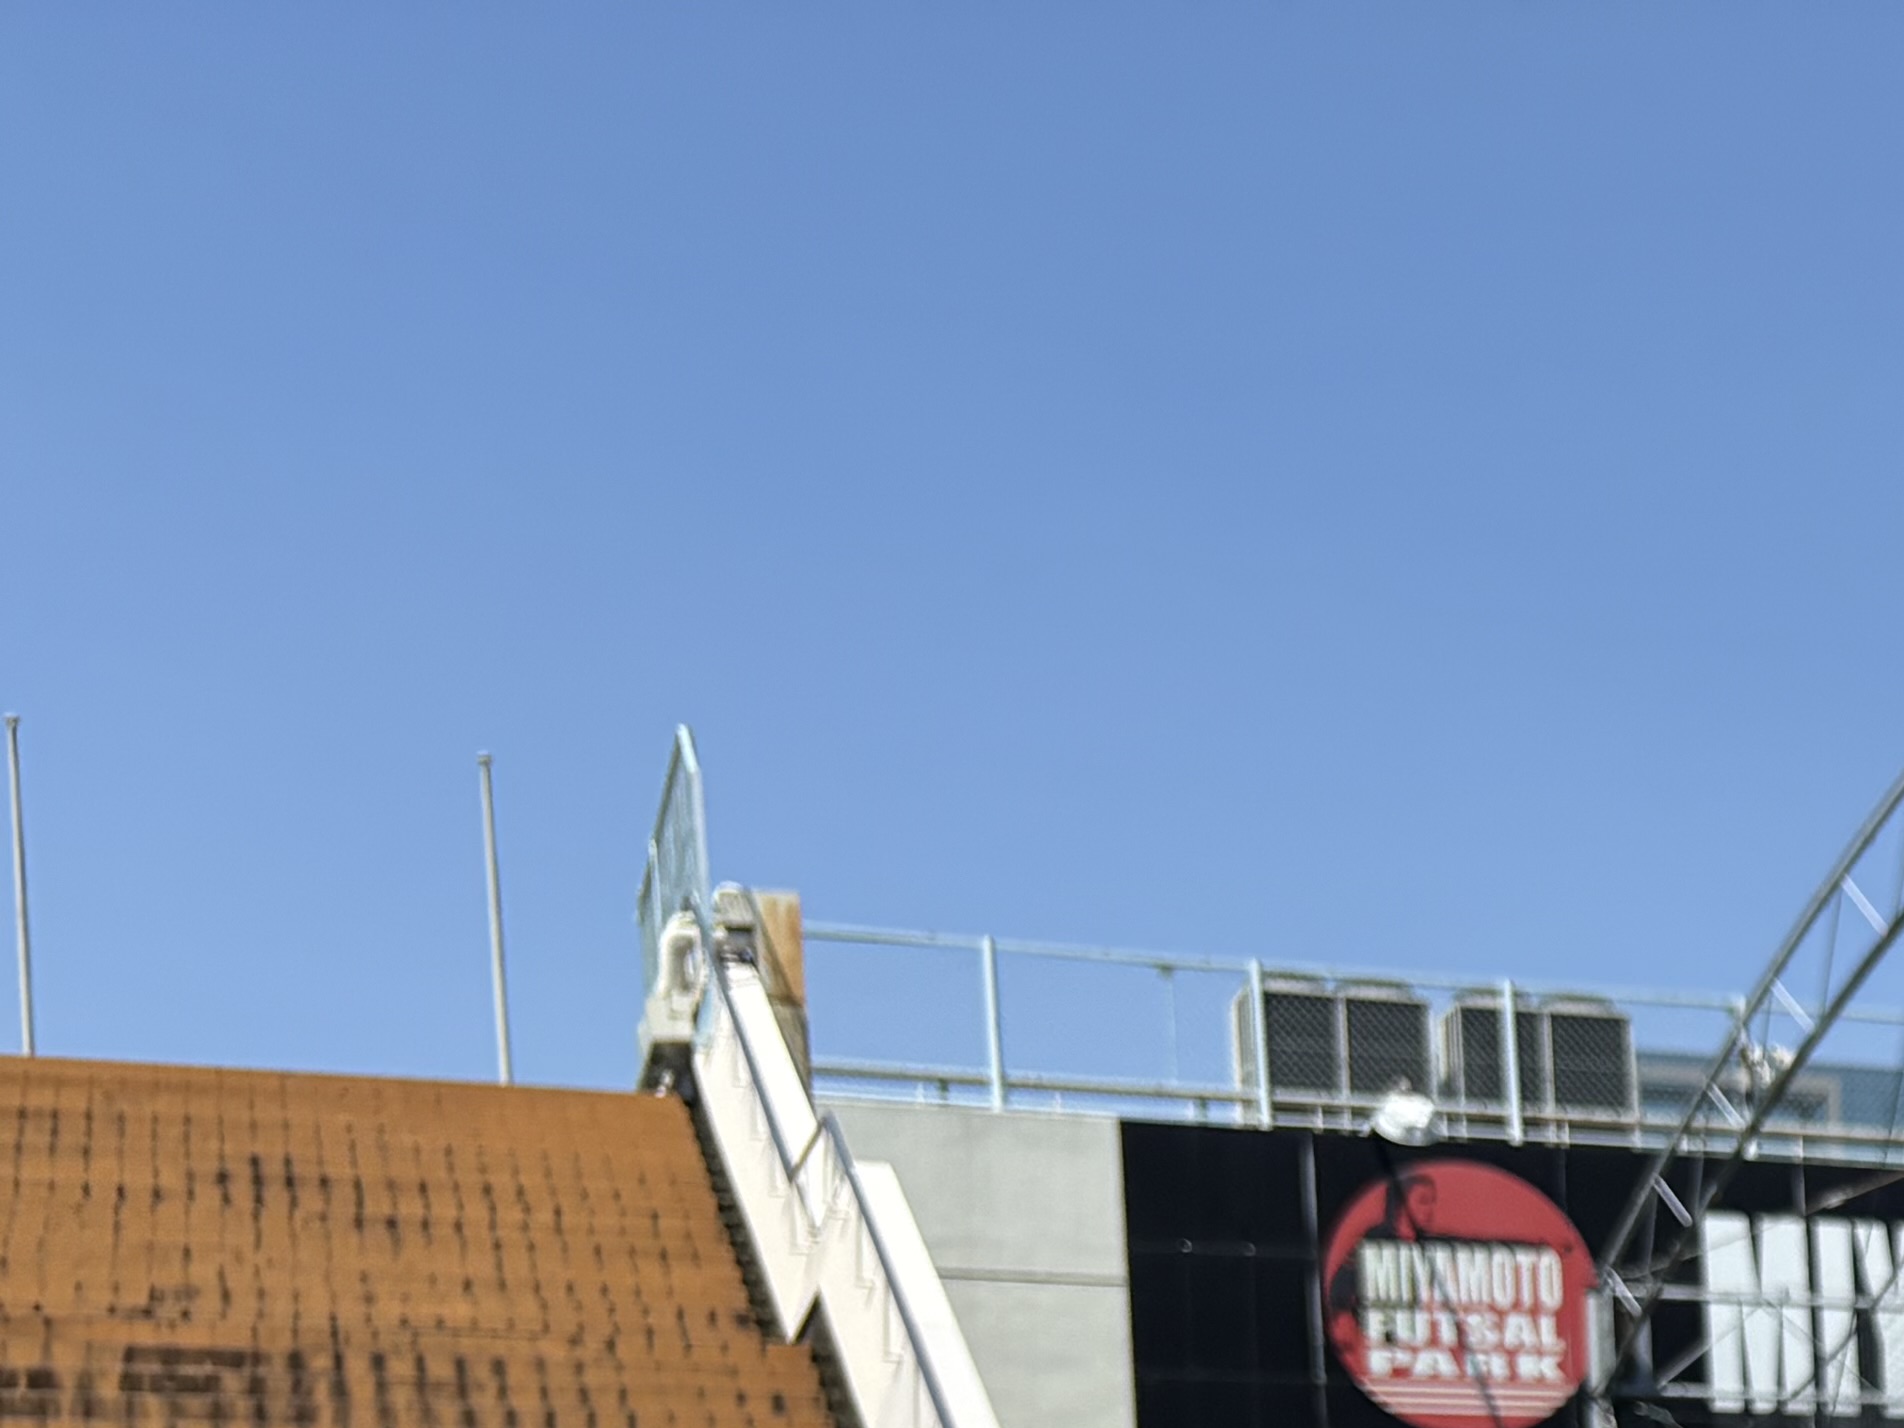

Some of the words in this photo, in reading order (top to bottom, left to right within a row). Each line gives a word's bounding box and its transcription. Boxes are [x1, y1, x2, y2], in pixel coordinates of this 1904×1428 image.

[1361, 1238, 1563, 1311] MIYAMOTO
[1366, 1306, 1567, 1352] FUTSAL
[1367, 1350, 1570, 1382] PARK
